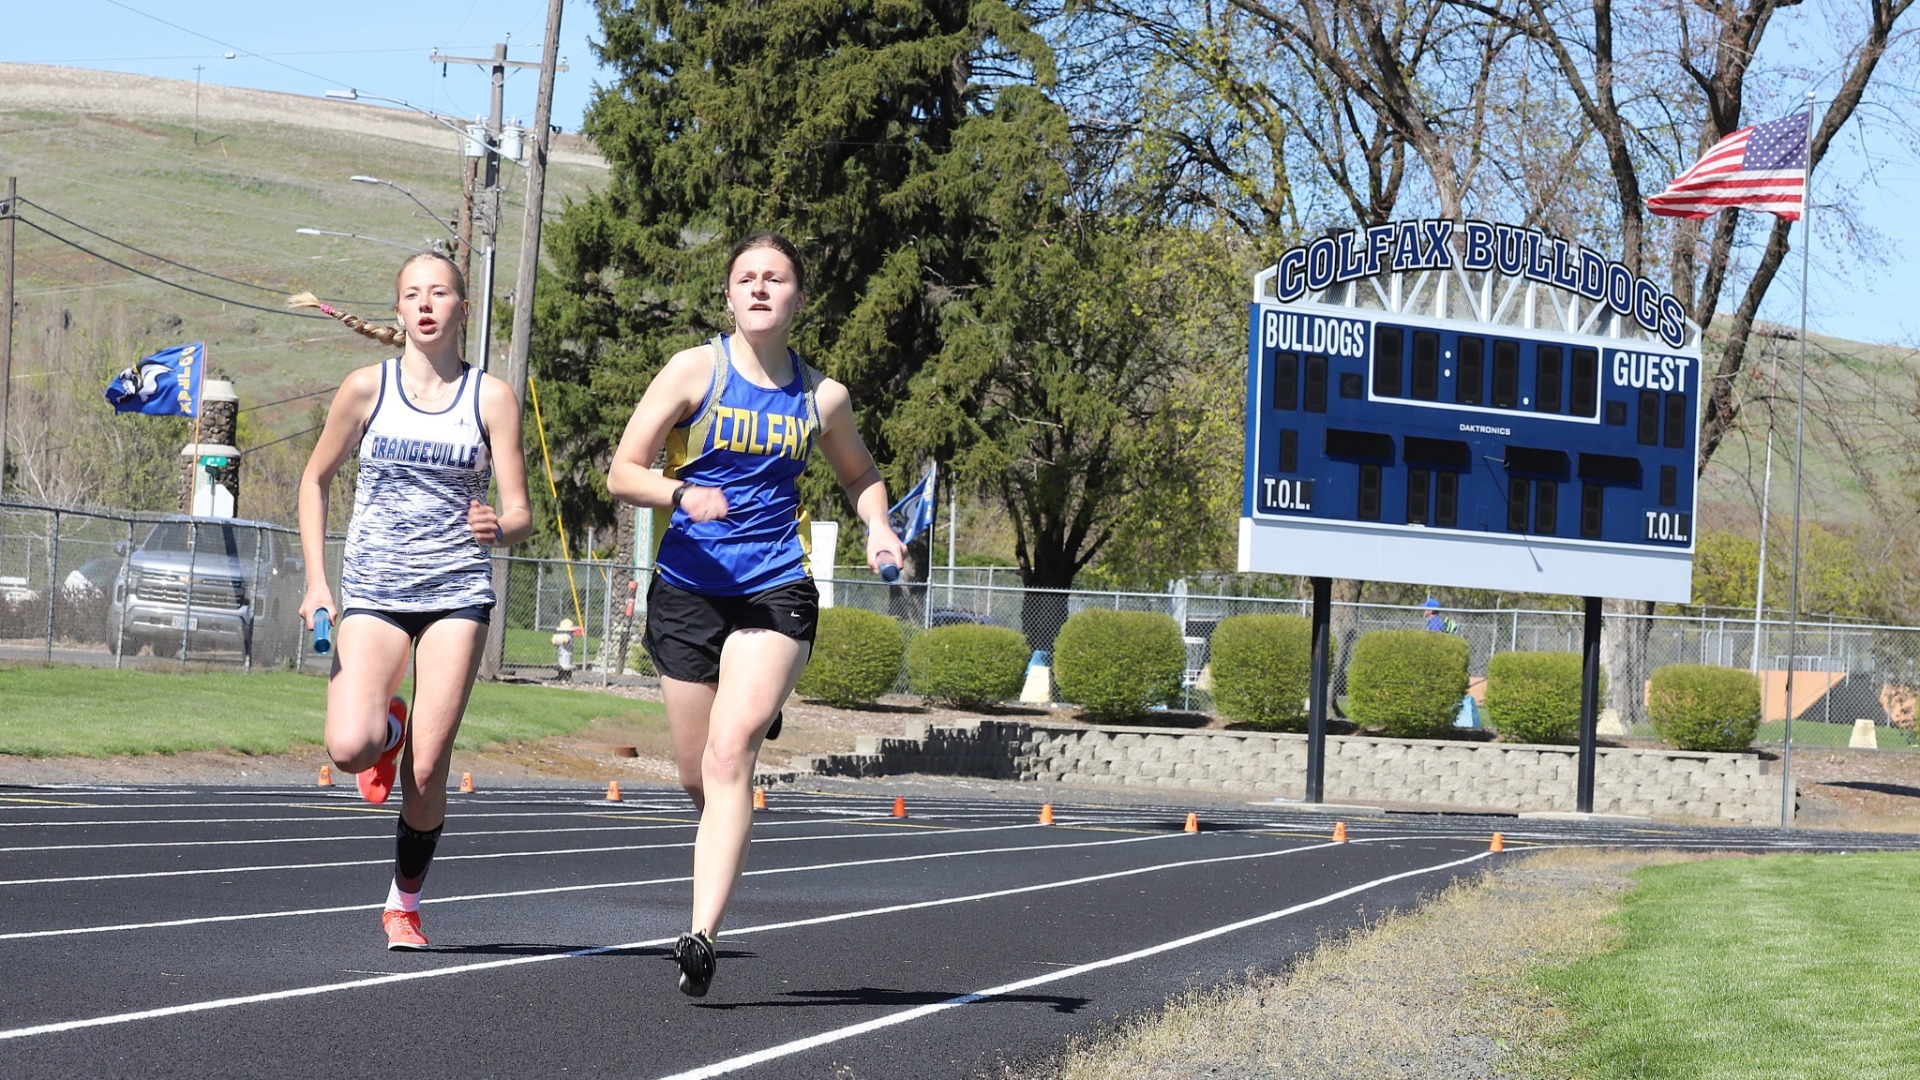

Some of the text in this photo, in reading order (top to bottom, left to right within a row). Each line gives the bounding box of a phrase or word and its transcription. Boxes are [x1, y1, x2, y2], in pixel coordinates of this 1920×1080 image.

[1276, 218, 1686, 349] COLFAX BULLDOGS
[1266, 312, 1365, 358] BULLDOGS
[1613, 351, 1690, 392] GUEST
[714, 405, 811, 461] COLFAX
[1459, 423, 1511, 436] DAKTRONICS
[1264, 478, 1310, 510] T.O.L.
[638, 507, 648, 561] CHMUCK
[1646, 511, 1687, 542] T.O.L.
[1337, 827, 1343, 836] 2
